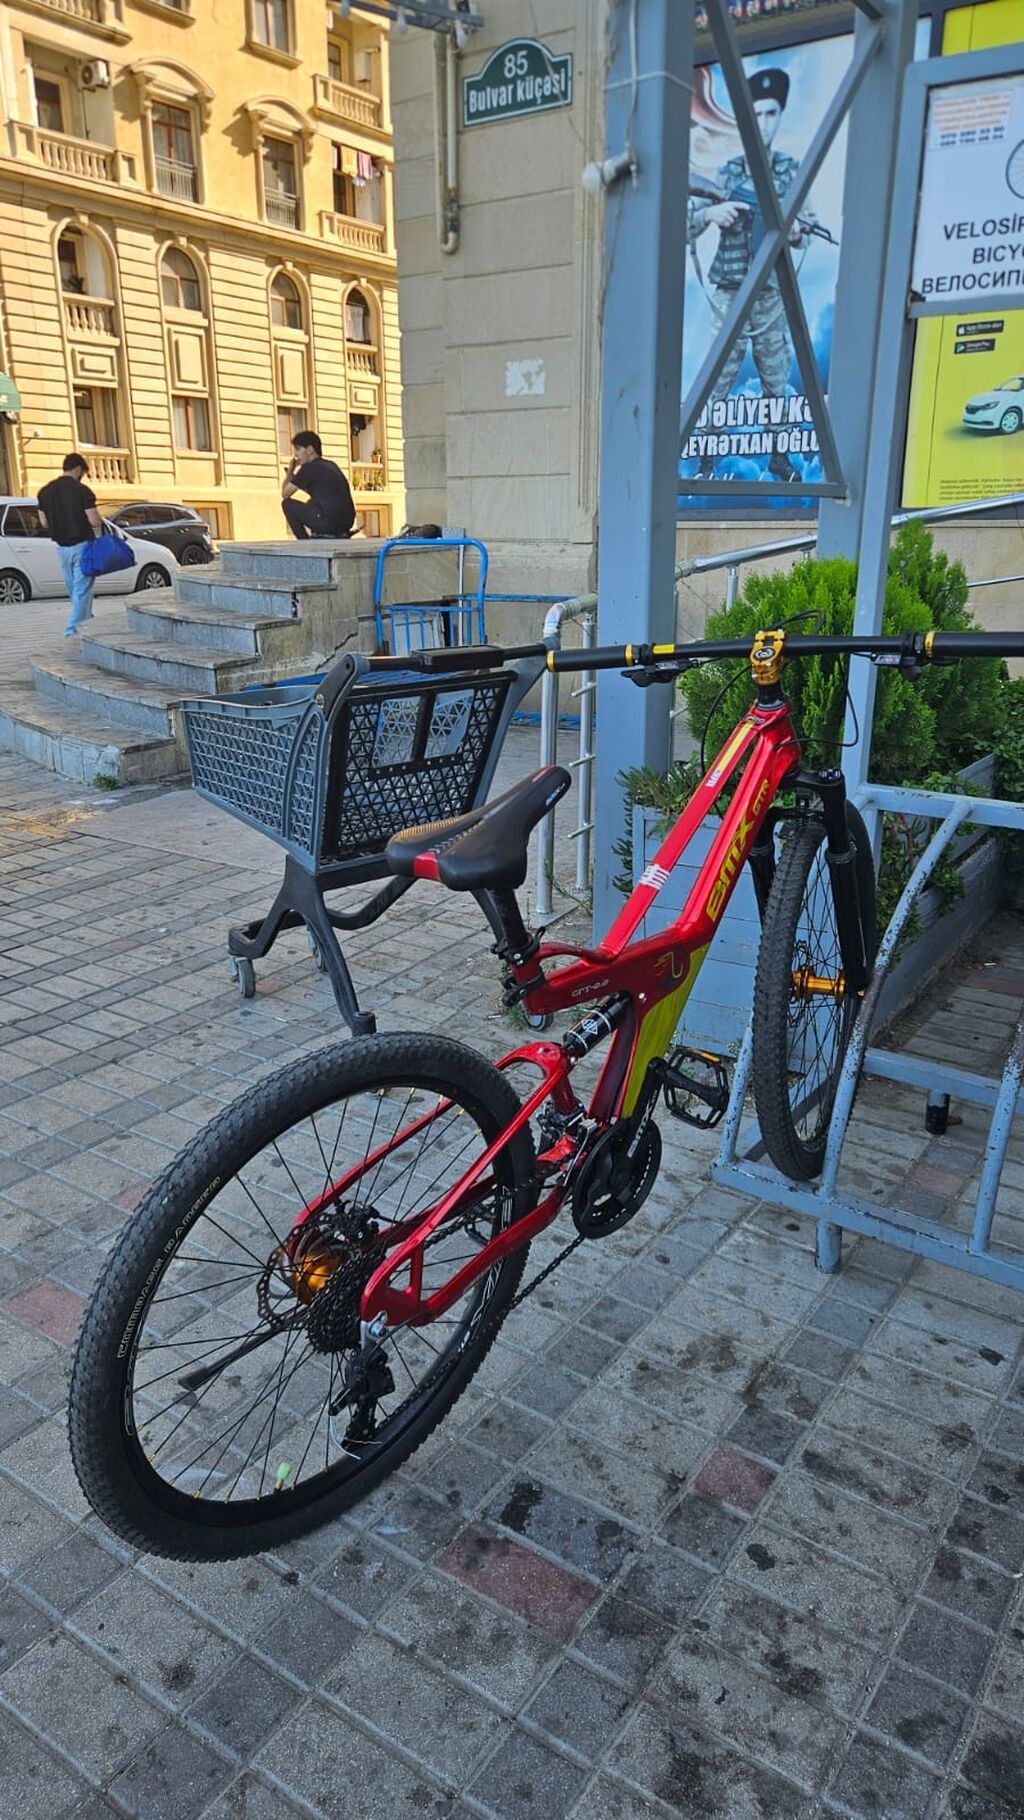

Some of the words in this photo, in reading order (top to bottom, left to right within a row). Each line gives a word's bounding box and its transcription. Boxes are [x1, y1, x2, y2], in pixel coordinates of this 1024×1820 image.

[504, 51, 528, 78] 85
[469, 84, 514, 113] Bulvar
[972, 244, 1024, 264] BICY
[921, 269, 1024, 294] ВЕЛОСИП
[713, 395, 785, 427] ƏLİYEV
